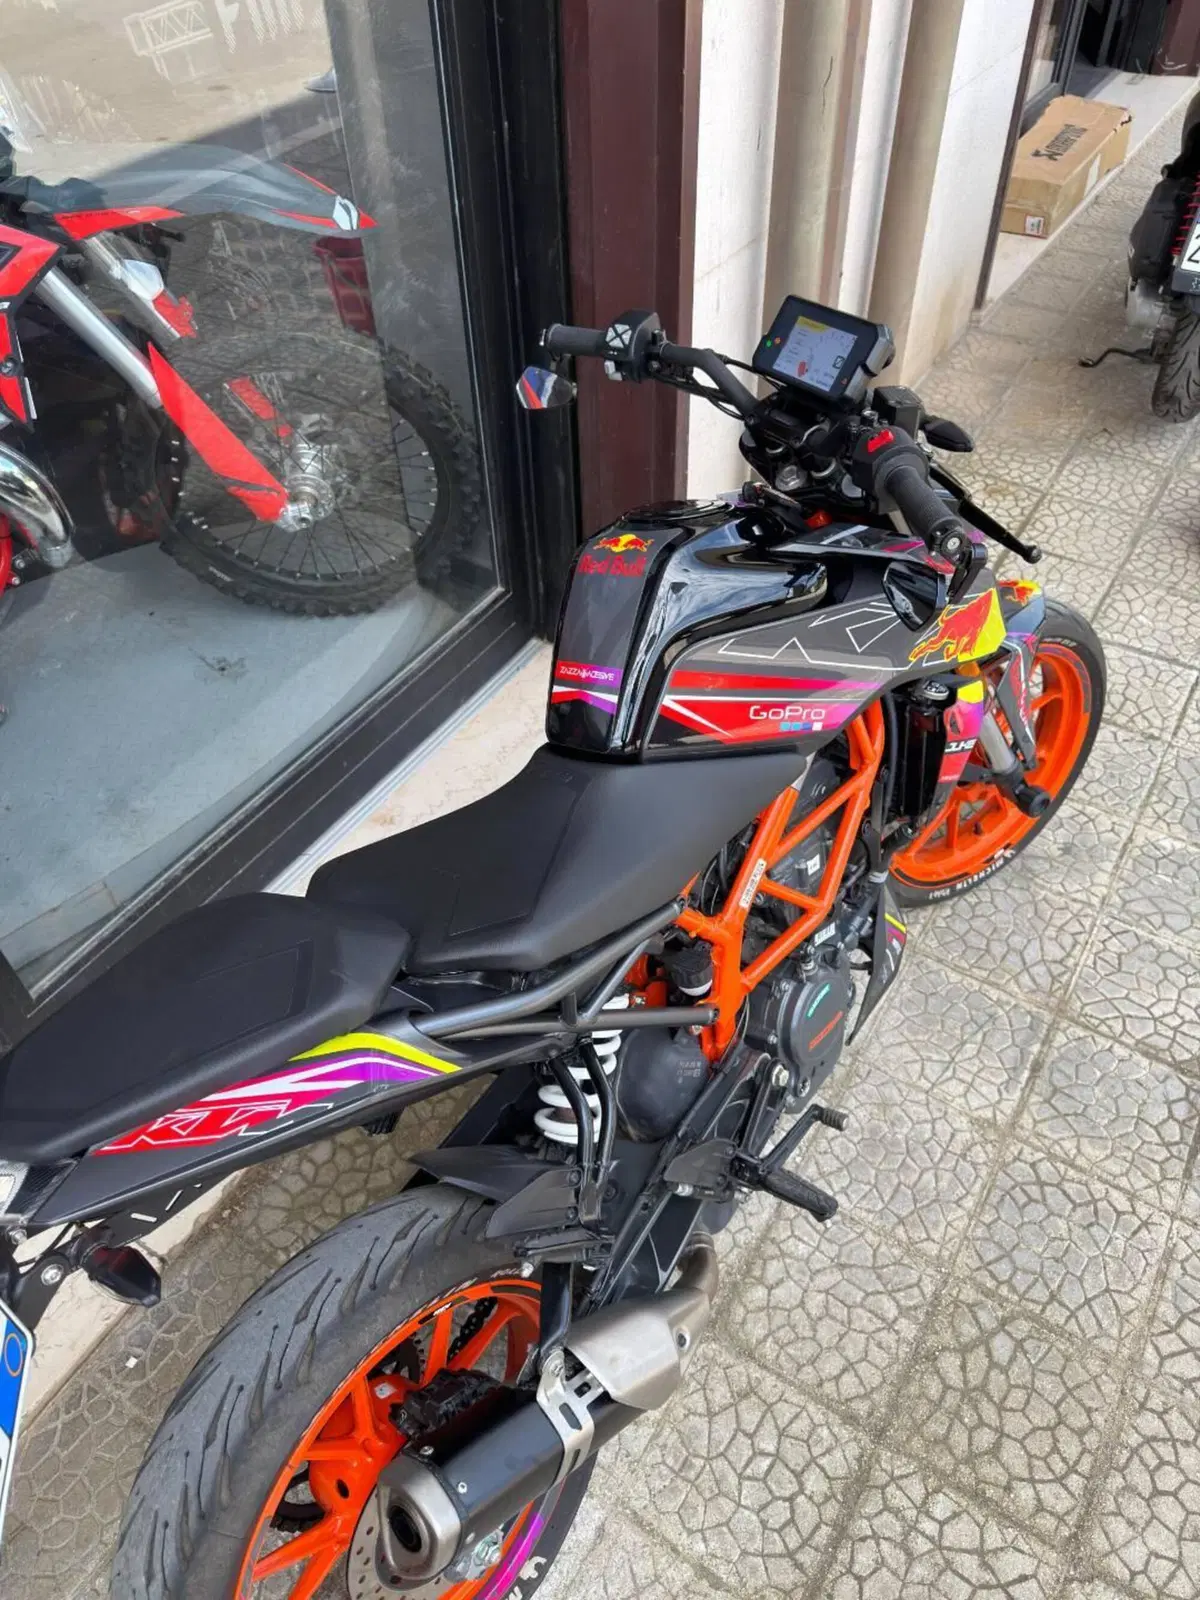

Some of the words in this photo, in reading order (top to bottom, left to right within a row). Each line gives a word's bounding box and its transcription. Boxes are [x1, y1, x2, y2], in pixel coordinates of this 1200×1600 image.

[578, 553, 610, 575] Red
[610, 555, 647, 577] Bull
[749, 705, 826, 720] GoPro
[955, 857, 1004, 890] MICHELIN
